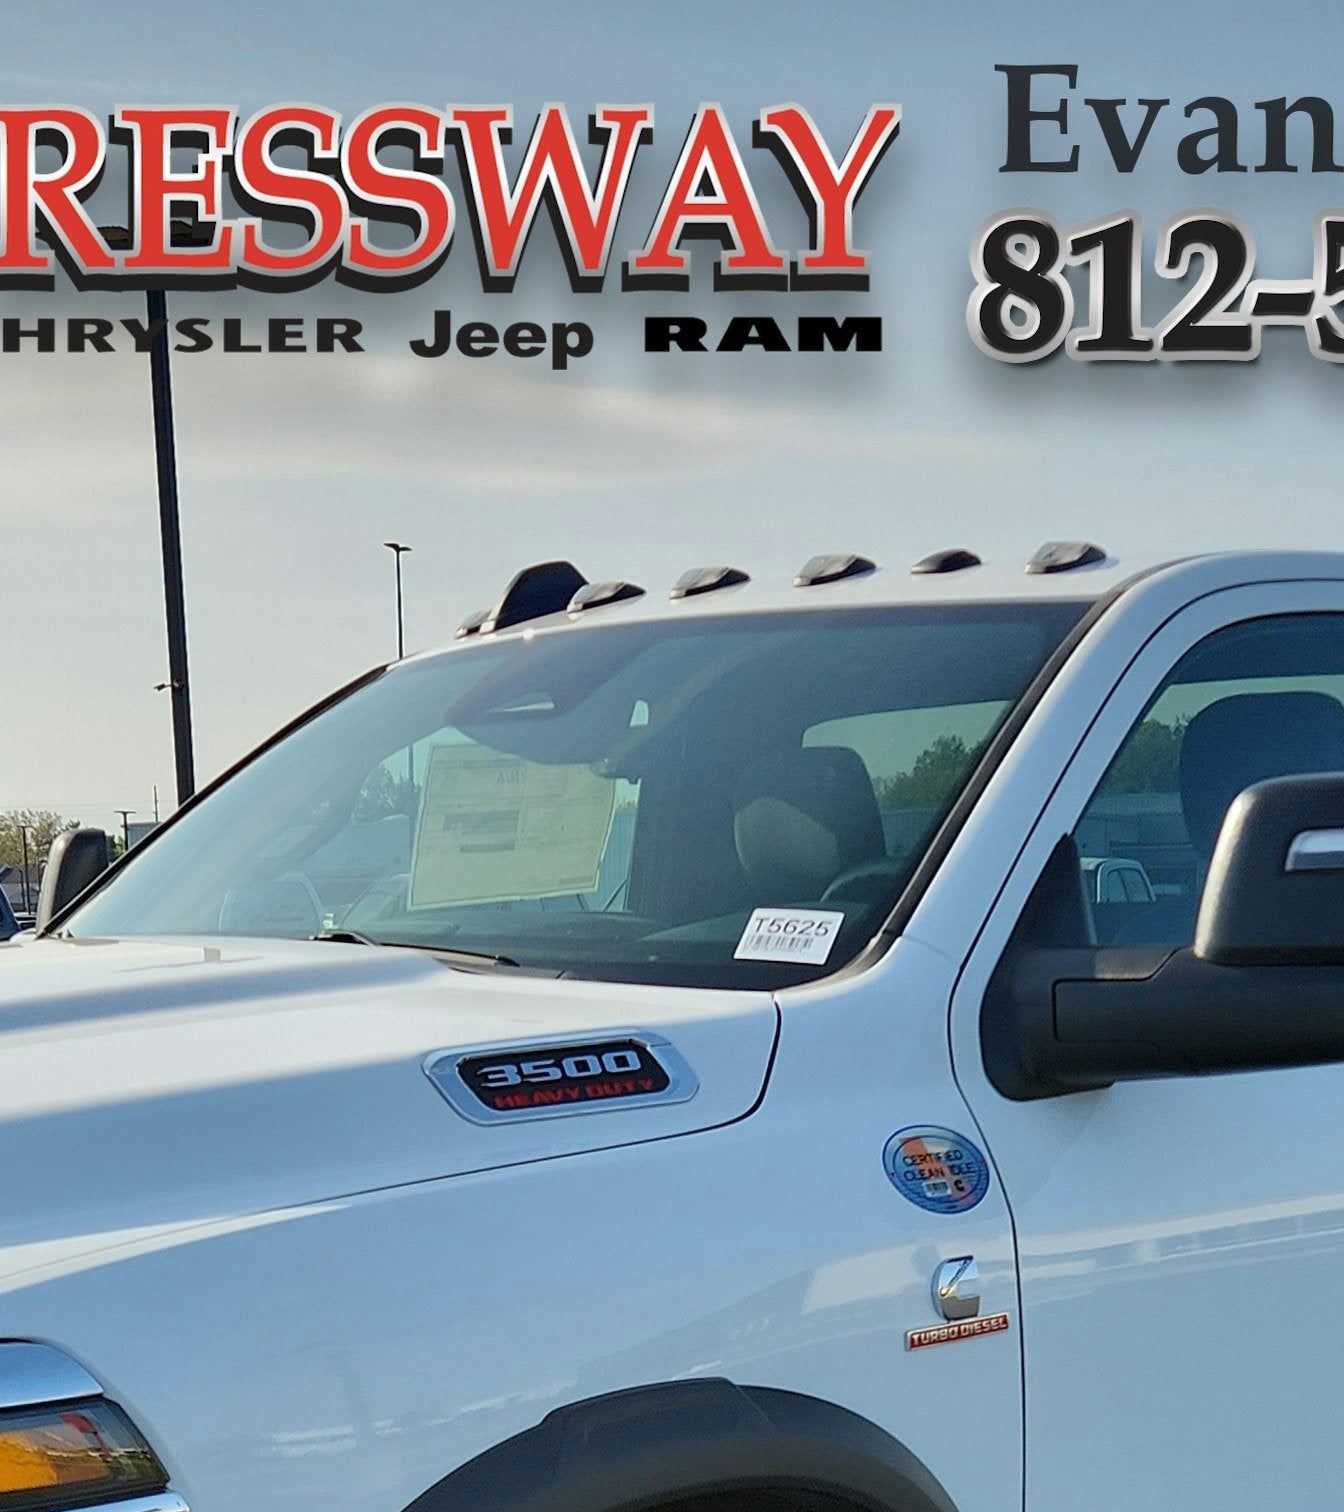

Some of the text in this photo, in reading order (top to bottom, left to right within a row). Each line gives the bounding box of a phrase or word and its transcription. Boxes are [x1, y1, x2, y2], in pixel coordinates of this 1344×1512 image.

[754, 917, 834, 937] T5625
[475, 1050, 642, 1088] 3500
[492, 1077, 654, 1109] HEAVY DUTY
[911, 1317, 1008, 1346] TURBO DIESEL
